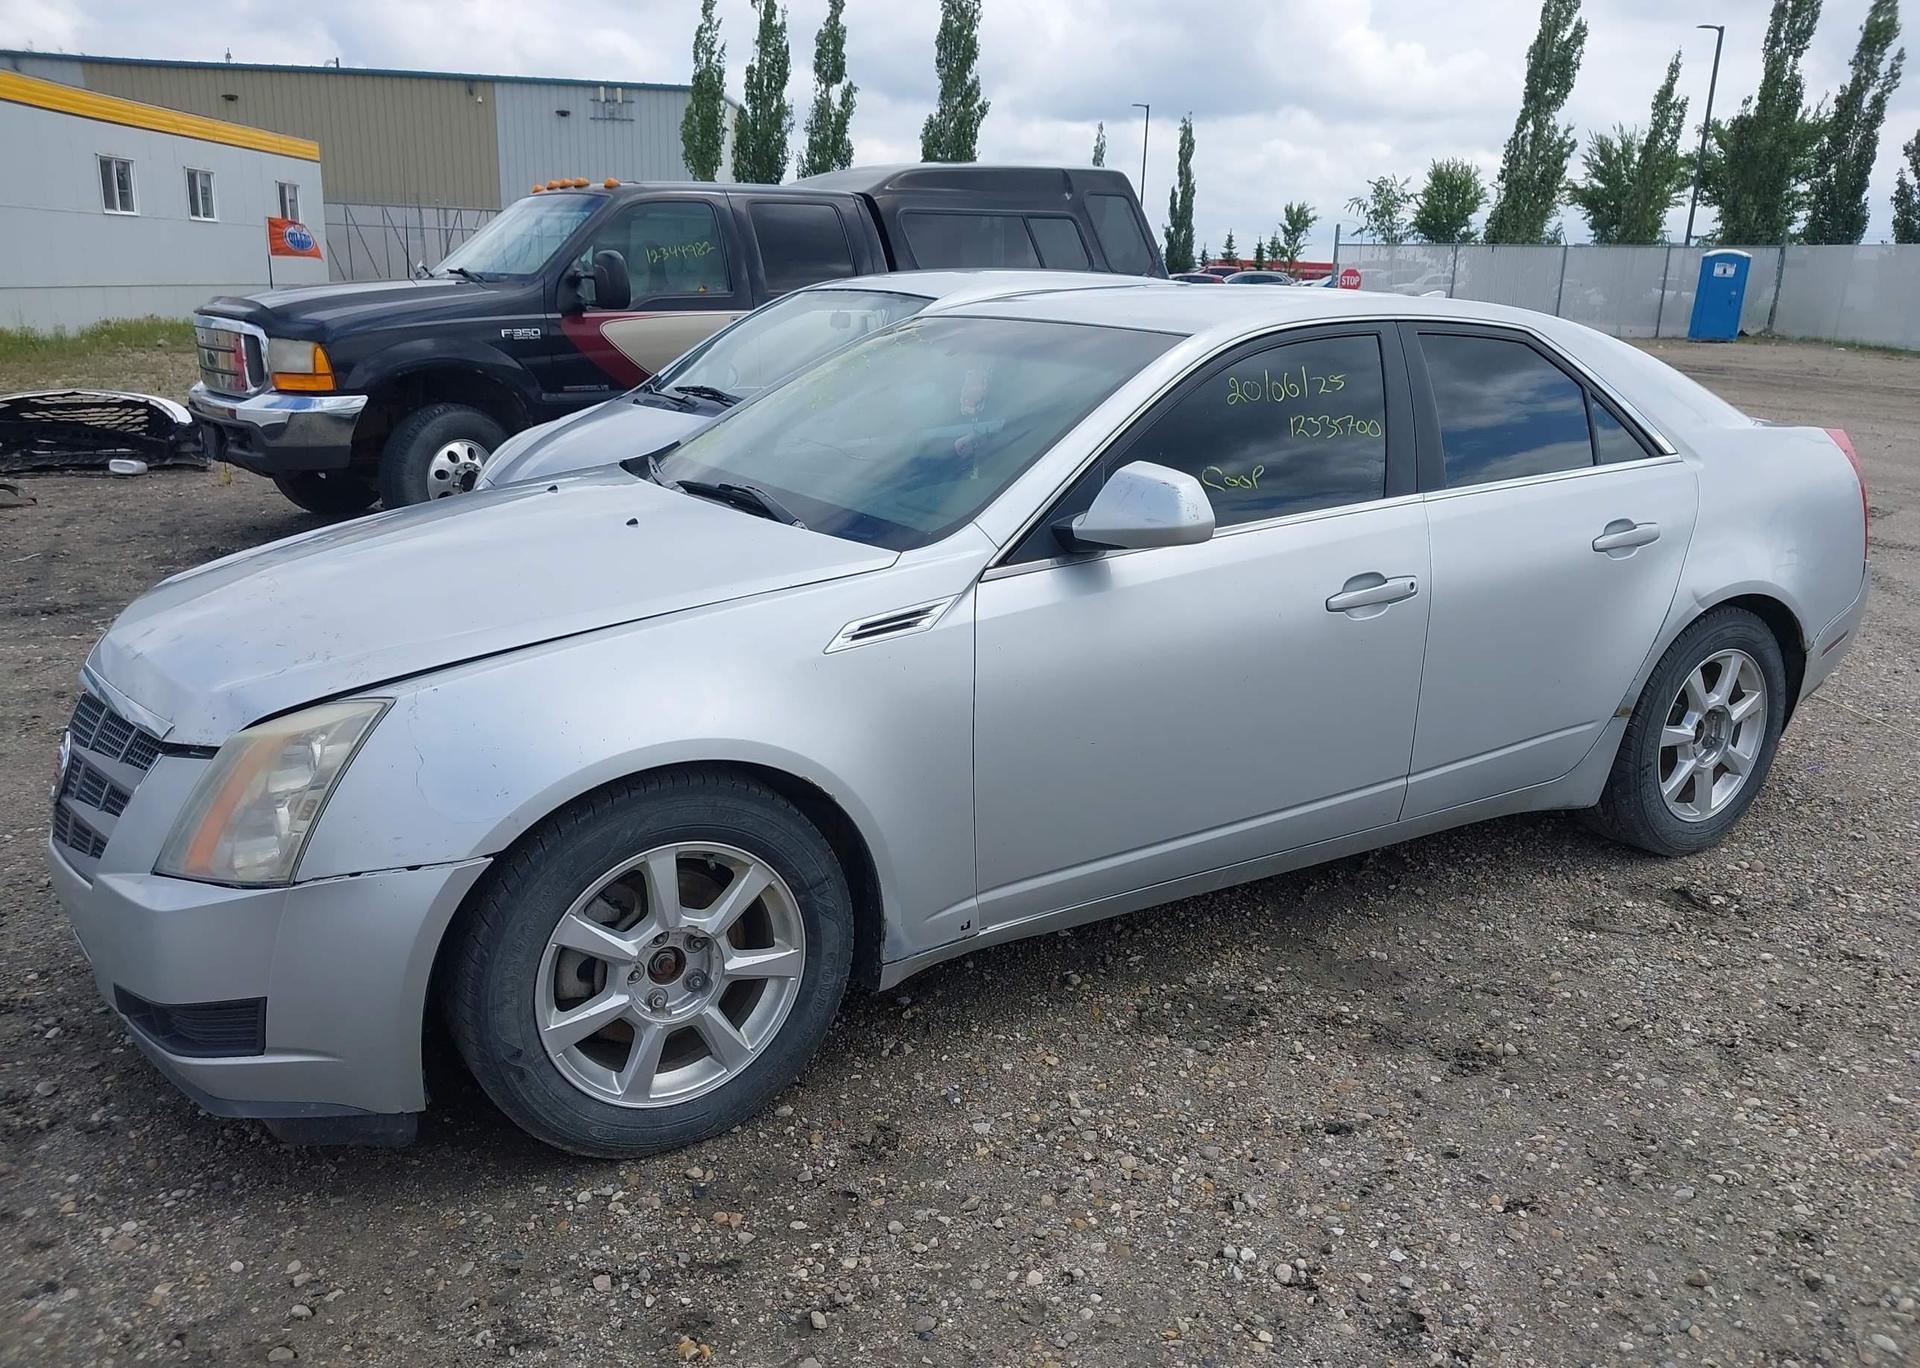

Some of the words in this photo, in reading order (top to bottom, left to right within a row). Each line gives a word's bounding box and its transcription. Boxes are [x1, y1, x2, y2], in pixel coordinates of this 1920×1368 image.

[645, 241, 716, 264] 12344982
[1341, 275, 1360, 286] STOP
[1227, 365, 1347, 406] 20/06/25
[1289, 414, 1383, 439] 12335700
